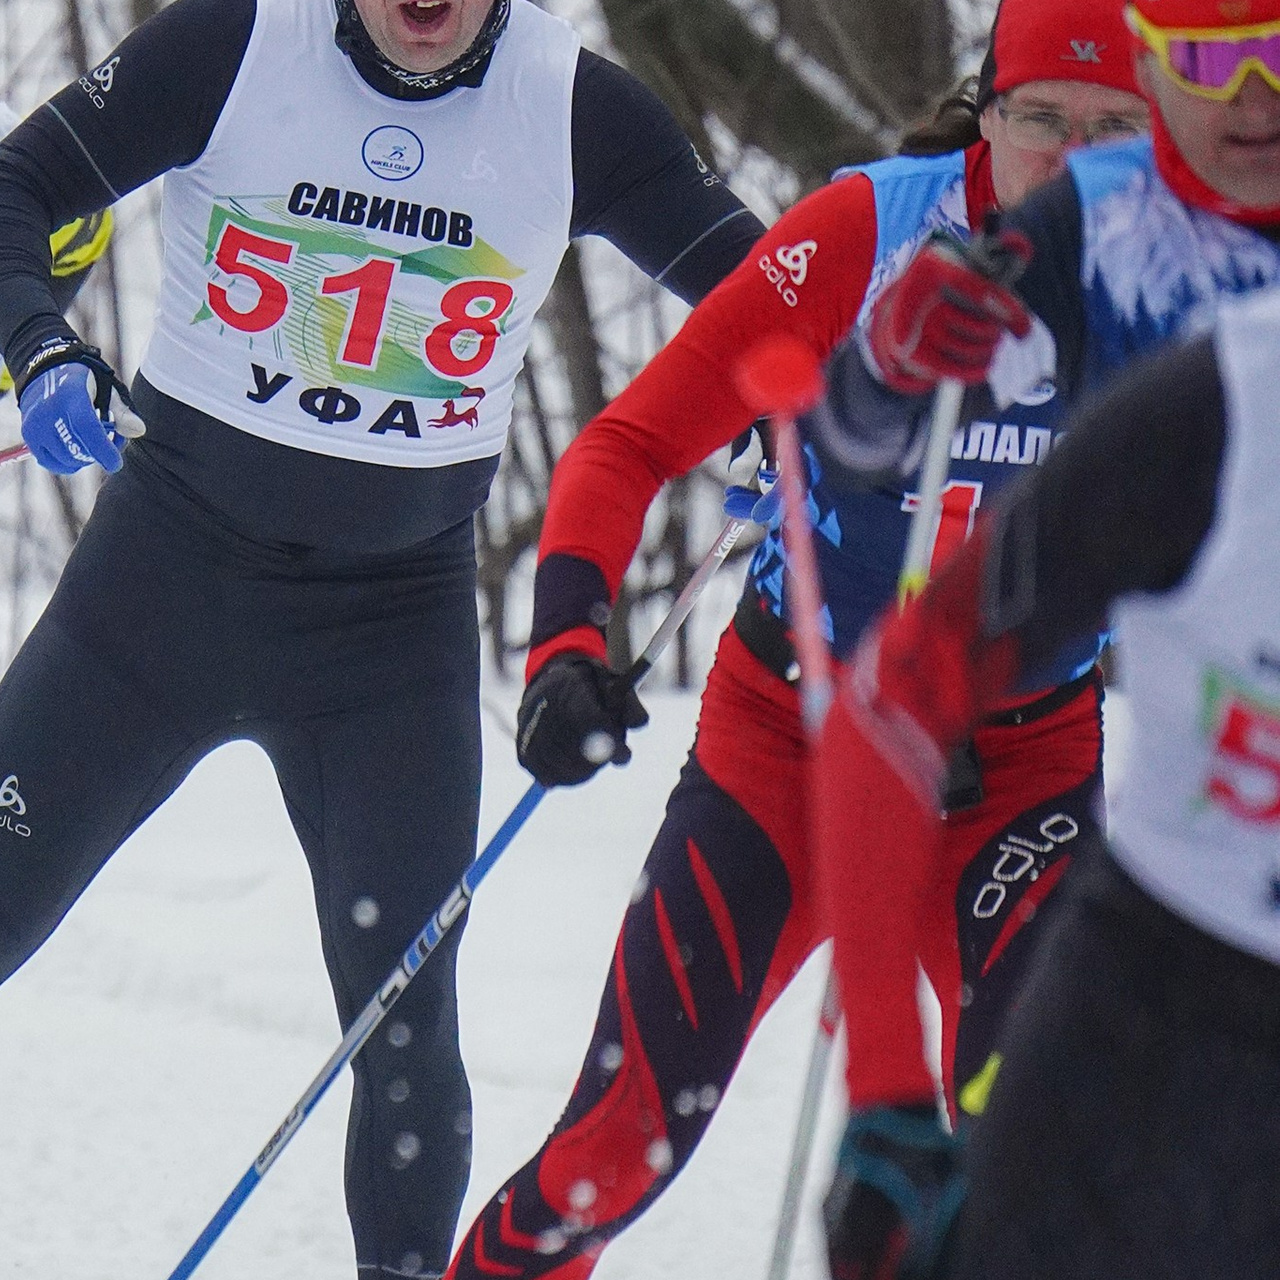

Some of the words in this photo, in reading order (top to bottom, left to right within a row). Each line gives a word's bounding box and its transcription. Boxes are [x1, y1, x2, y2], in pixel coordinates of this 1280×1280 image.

[287, 181, 474, 248] САВИНОВ
[207, 223, 514, 378] 518
[758, 254, 798, 308] odlo
[246, 362, 422, 439] УФА
[973, 812, 1080, 920] odlo
